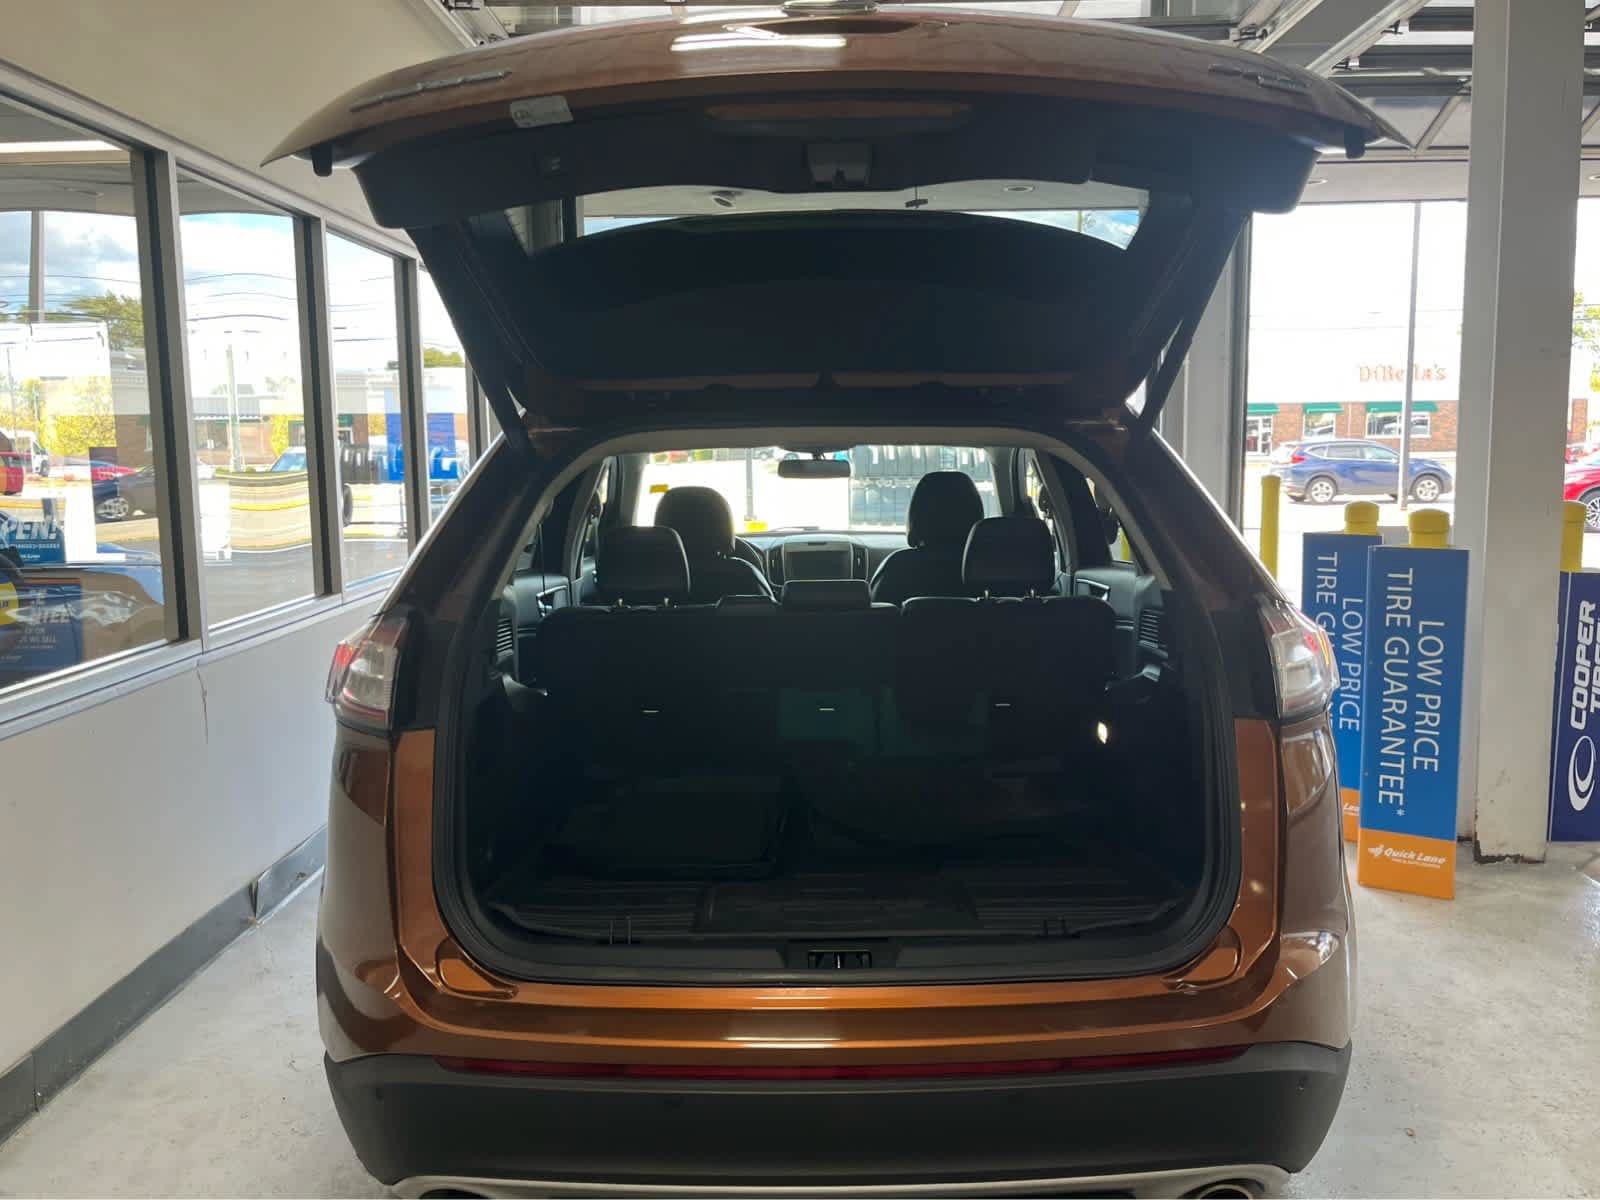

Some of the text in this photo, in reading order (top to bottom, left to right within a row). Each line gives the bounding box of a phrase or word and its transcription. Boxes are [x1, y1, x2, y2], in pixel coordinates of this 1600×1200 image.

[1358, 363, 1447, 383] DiBela's
[1, 518, 57, 540] PEN!
[1316, 552, 1338, 604] TIRE
[1387, 567, 1413, 628] TIRE
[1339, 598, 1363, 731] LOW PRICE
[1570, 600, 1596, 730] COOPER
[1590, 618, 1600, 713] TIR
[1412, 620, 1445, 772] LOW PRICE
[1384, 847, 1417, 860] Quick
[1417, 852, 1447, 865] Lane
